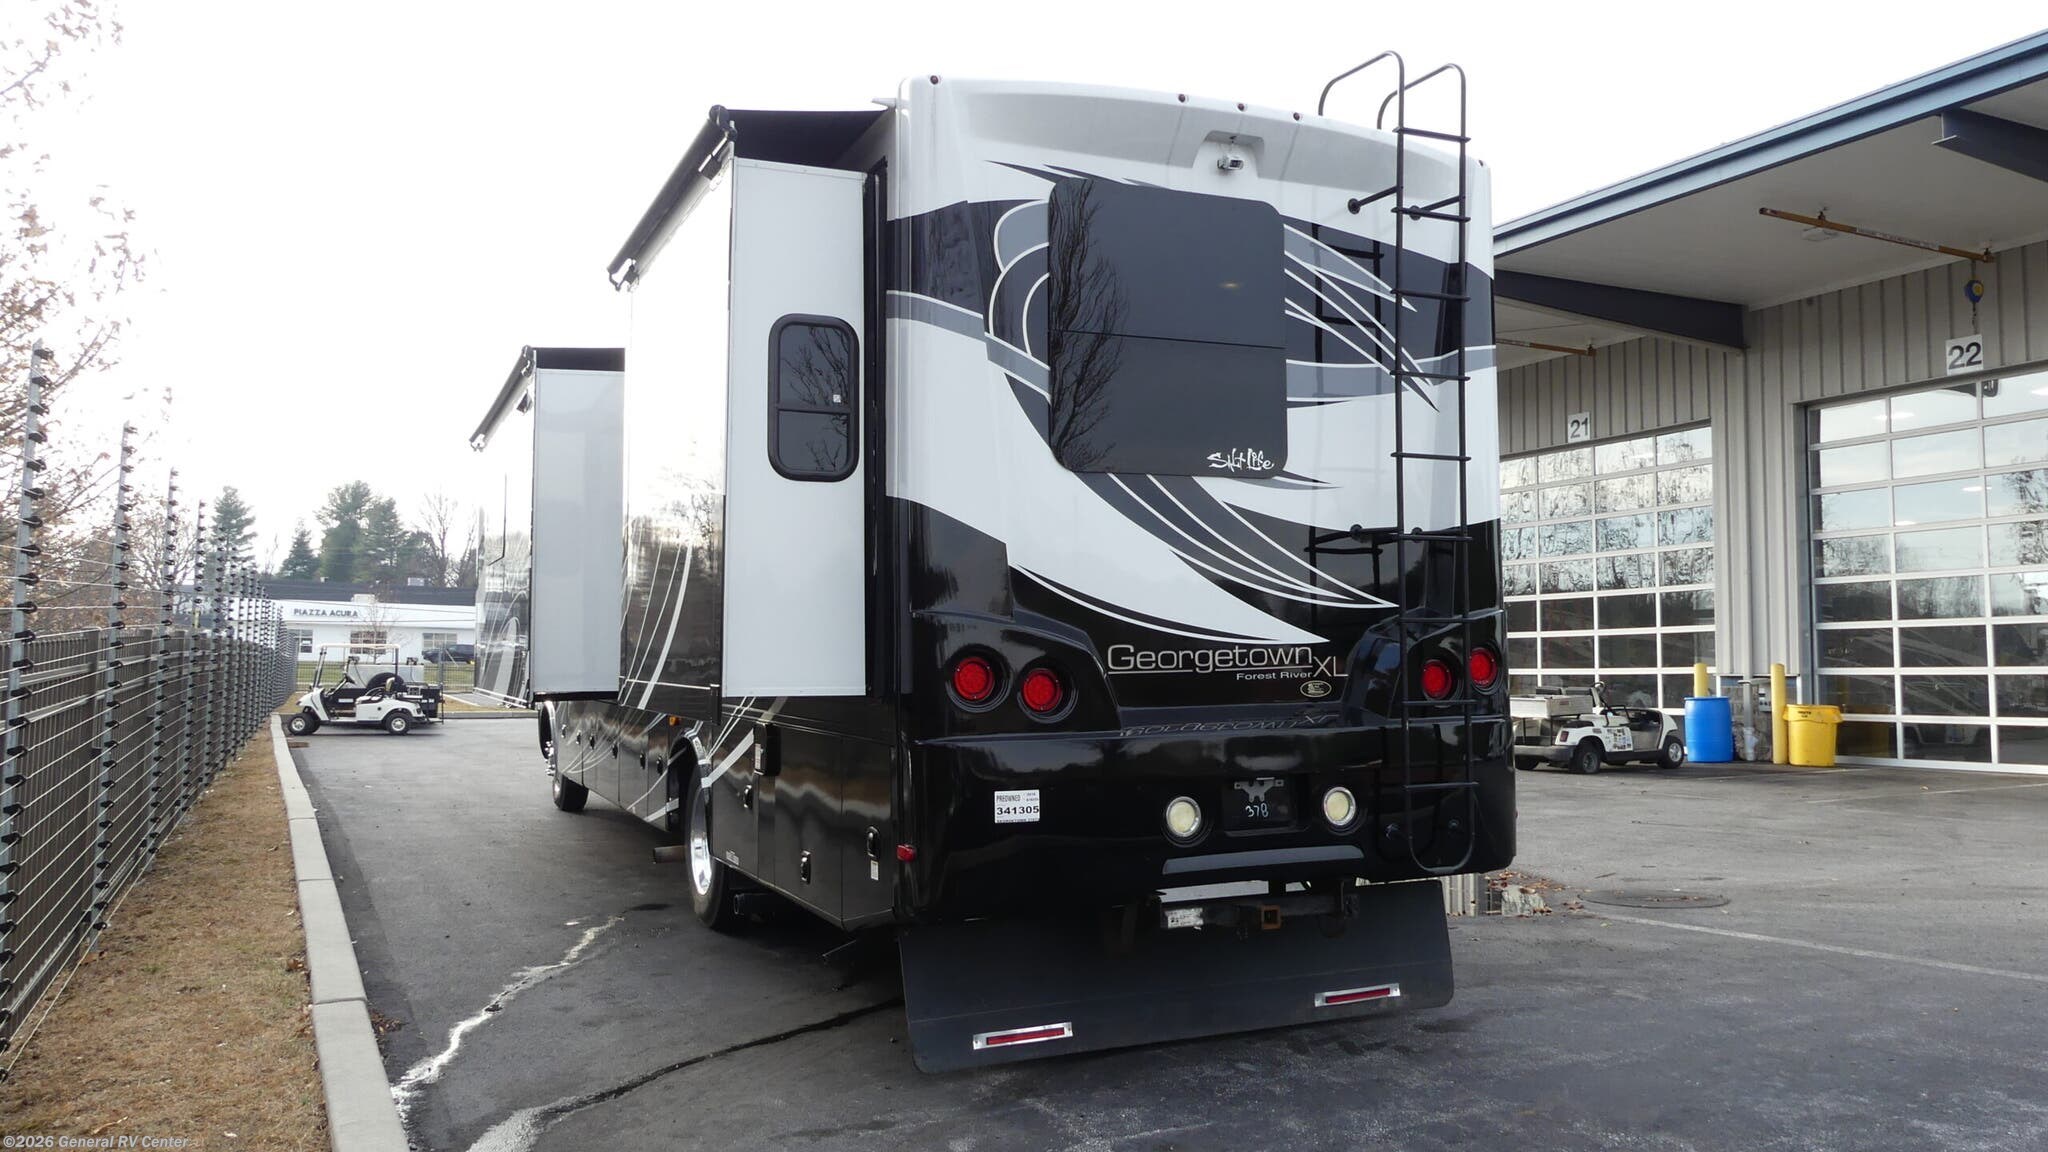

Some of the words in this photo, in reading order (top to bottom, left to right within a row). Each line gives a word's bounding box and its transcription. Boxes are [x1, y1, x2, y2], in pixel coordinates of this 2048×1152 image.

[1948, 341, 1982, 370] 22
[1570, 416, 1589, 439] 21
[1246, 447, 1275, 471] Life
[293, 608, 327, 617] PIAZZA
[329, 609, 359, 618] ACURA
[1107, 644, 1312, 674] Georgetown
[1312, 655, 1349, 678] XL
[1236, 672, 1277, 680] Forest
[1280, 671, 1312, 679] River
[996, 805, 1040, 815] 341305
[1245, 802, 1269, 818] 378
